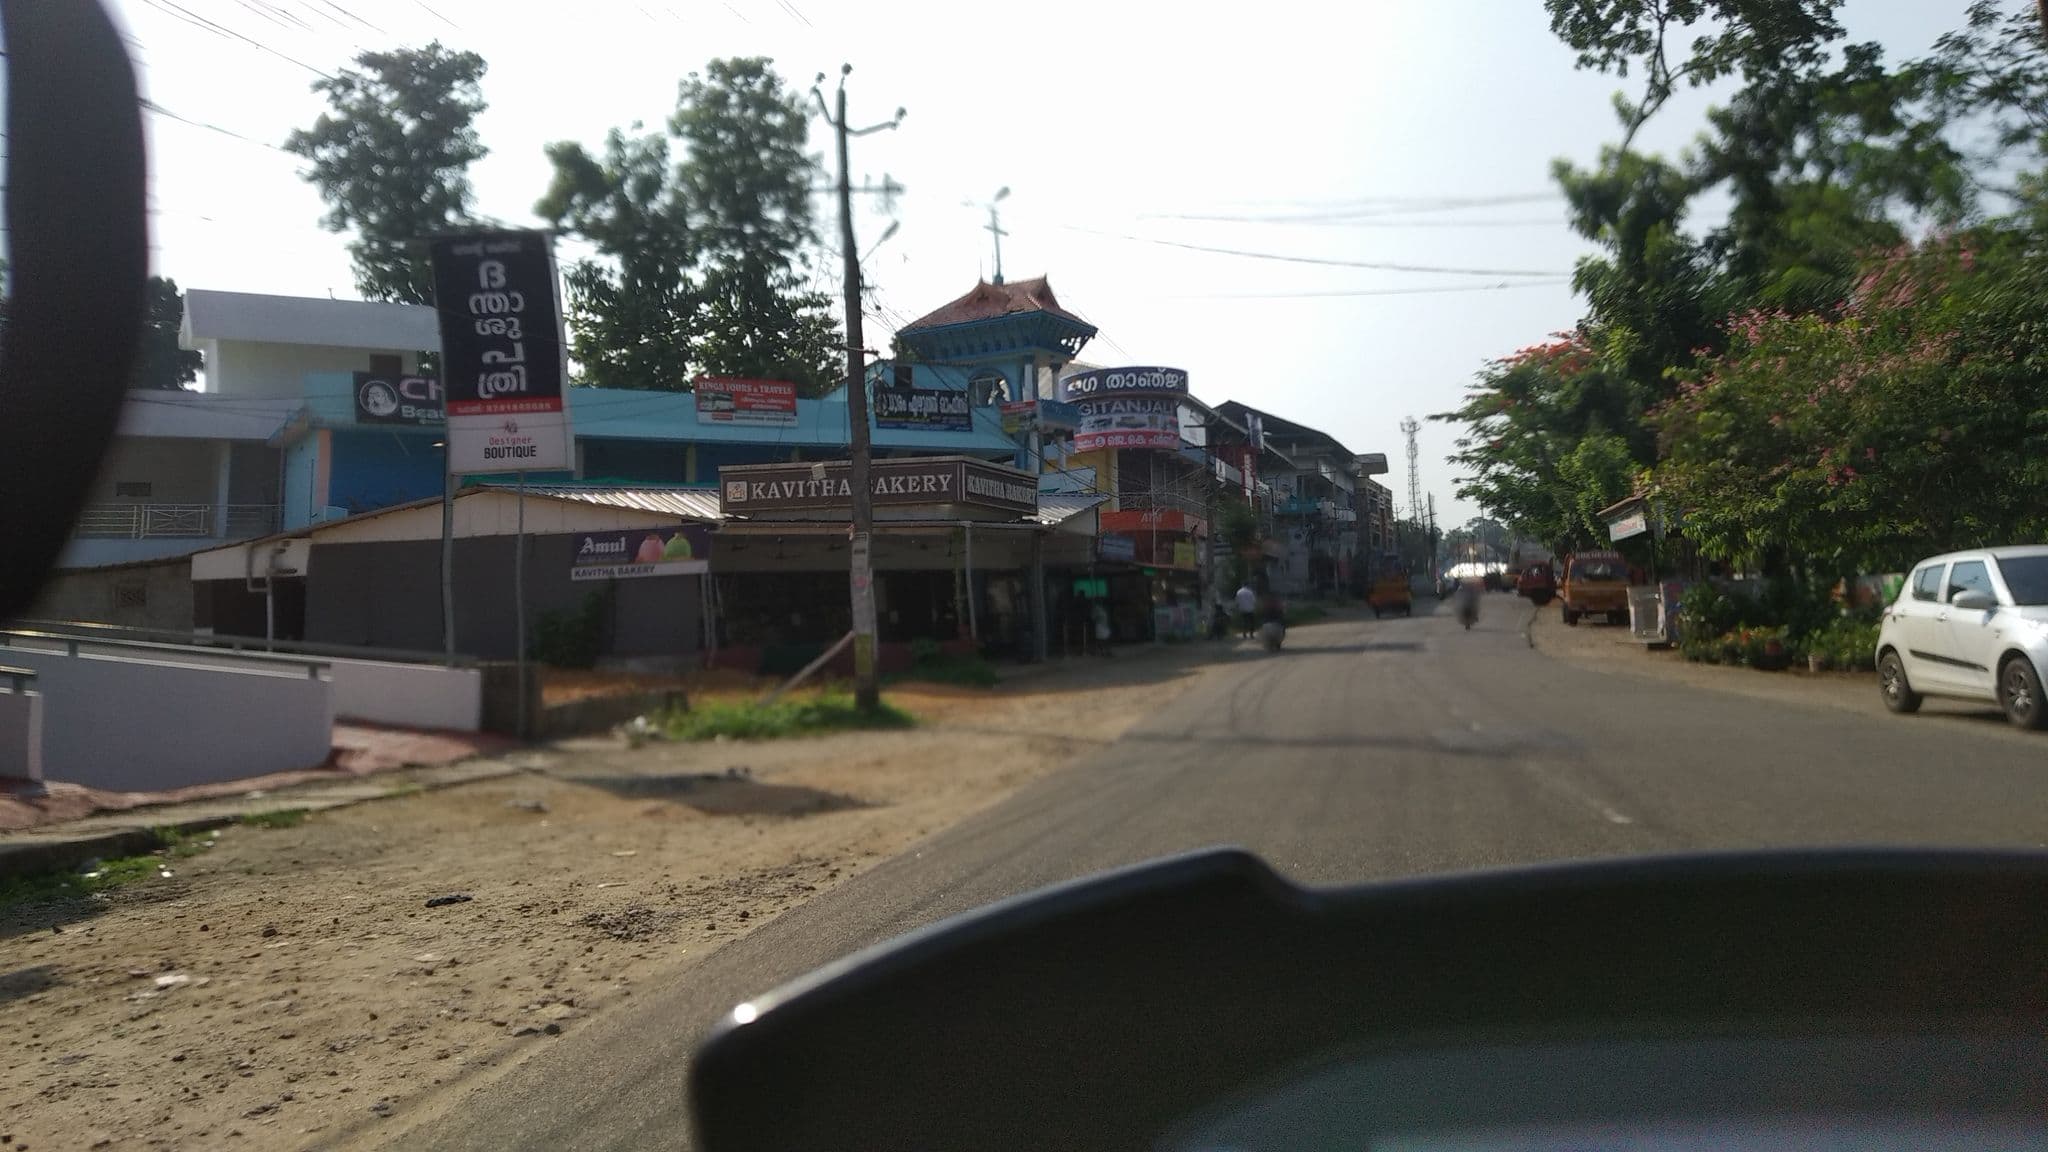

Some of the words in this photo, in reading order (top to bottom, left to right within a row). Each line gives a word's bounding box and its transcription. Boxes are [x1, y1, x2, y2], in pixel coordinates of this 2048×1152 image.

[725, 383, 752, 393] TOURS
[484, 446, 536, 459] BOUTIQUE
[752, 479, 852, 499] KAVITHA
[870, 474, 952, 495] AKERY
[967, 475, 1005, 498] KAVITHA
[1005, 483, 1037, 505] BAKERY
[580, 536, 626, 553] Amul
[575, 567, 615, 578] KAVITHA
[617, 565, 656, 576] BAKERY
